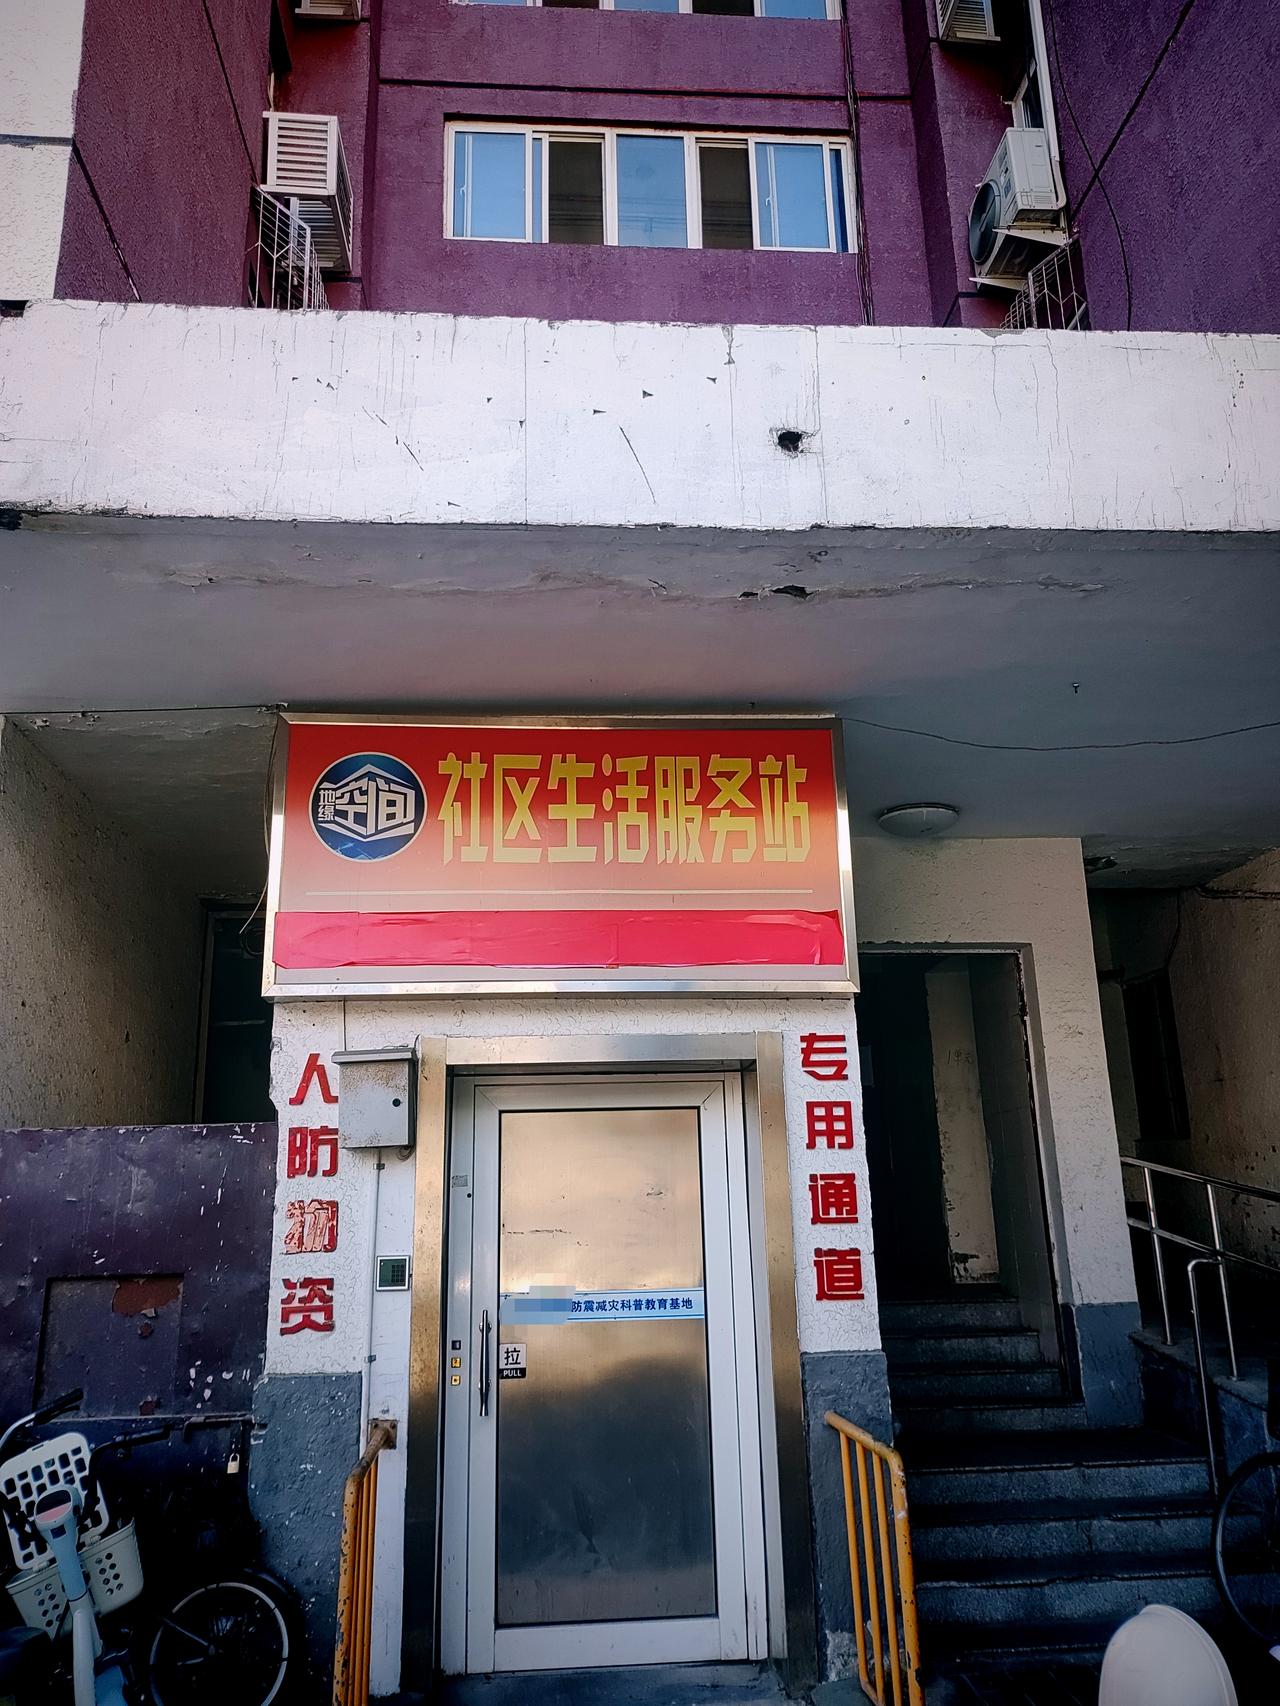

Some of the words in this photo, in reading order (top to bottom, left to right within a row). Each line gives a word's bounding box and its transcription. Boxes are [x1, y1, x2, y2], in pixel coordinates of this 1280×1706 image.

[438, 752, 812, 866] 社区生活服务站
[280, 1052, 340, 1337] 人防物资
[800, 1032, 865, 1301] 专用通道
[571, 1297, 694, 1313] 防震减灾科普教育基地
[503, 1369, 522, 1377] PULL
[504, 1347, 521, 1366] 拉
